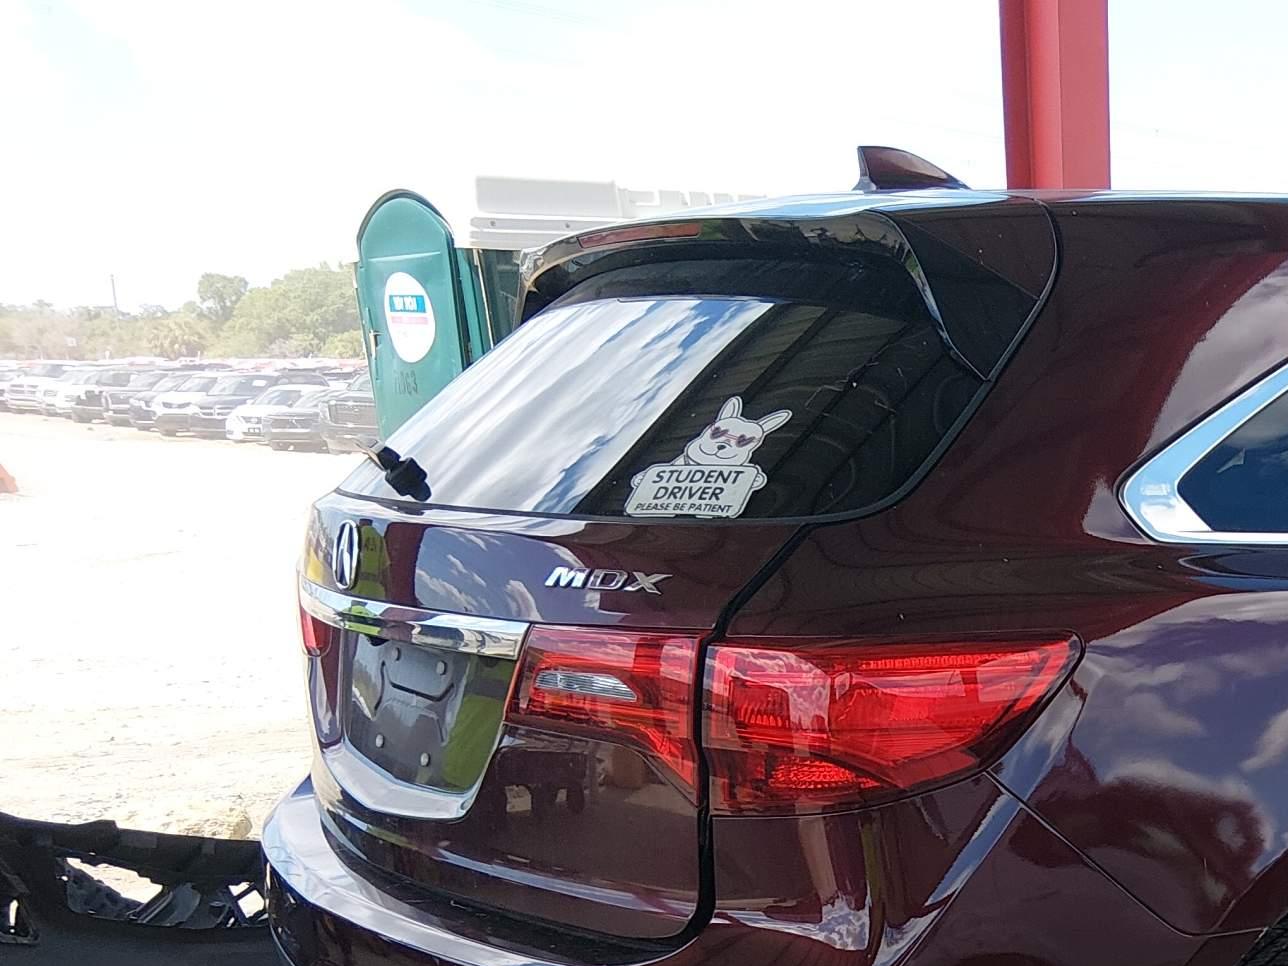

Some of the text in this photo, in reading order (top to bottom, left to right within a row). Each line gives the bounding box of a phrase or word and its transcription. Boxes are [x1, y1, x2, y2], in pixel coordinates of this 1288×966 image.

[652, 469, 744, 485] STUDENT
[652, 486, 725, 501] DRIVER
[634, 502, 733, 514] PLEASE BE PATIENT
[544, 566, 673, 595] MDX
